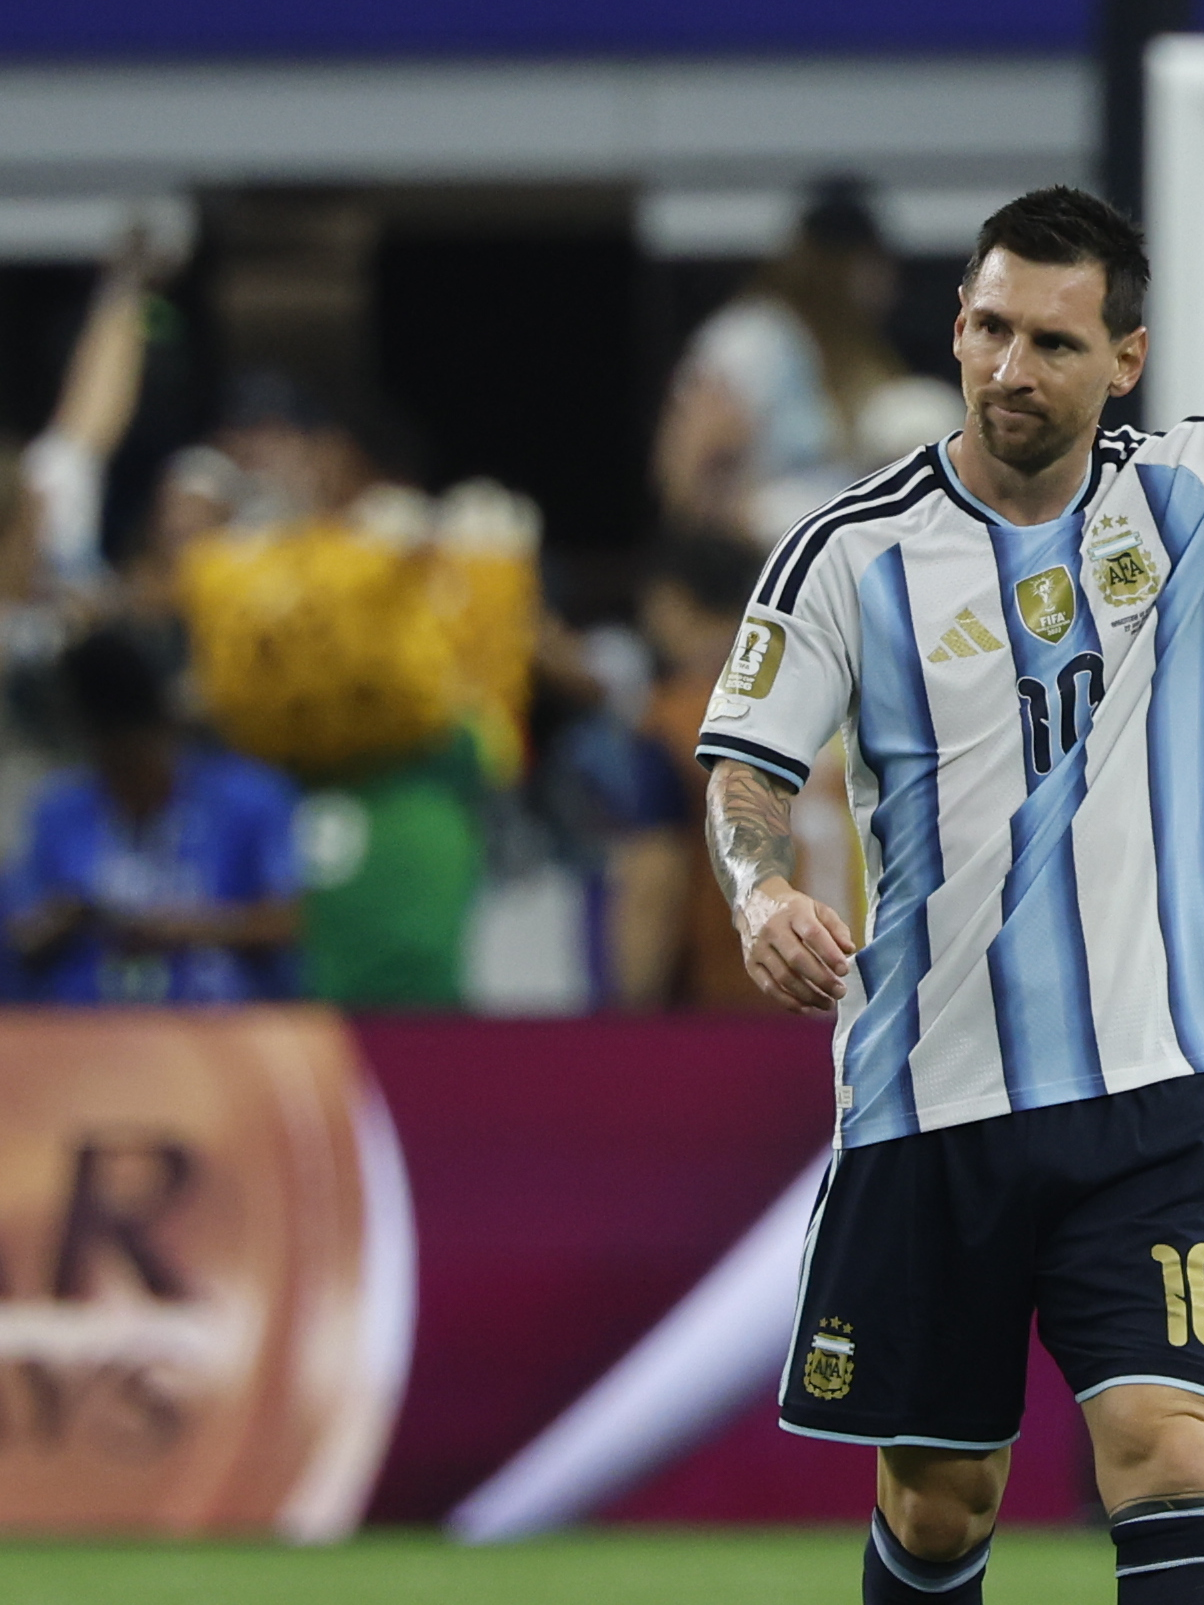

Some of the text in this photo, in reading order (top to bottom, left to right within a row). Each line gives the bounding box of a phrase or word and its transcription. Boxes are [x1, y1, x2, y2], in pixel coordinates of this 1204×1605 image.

[1106, 551, 1145, 586] AFA
[1040, 612, 1066, 628] FIFA
[1017, 649, 1107, 776] 10
[0, 1132, 195, 1305] R
[813, 1349, 843, 1383] AFA
